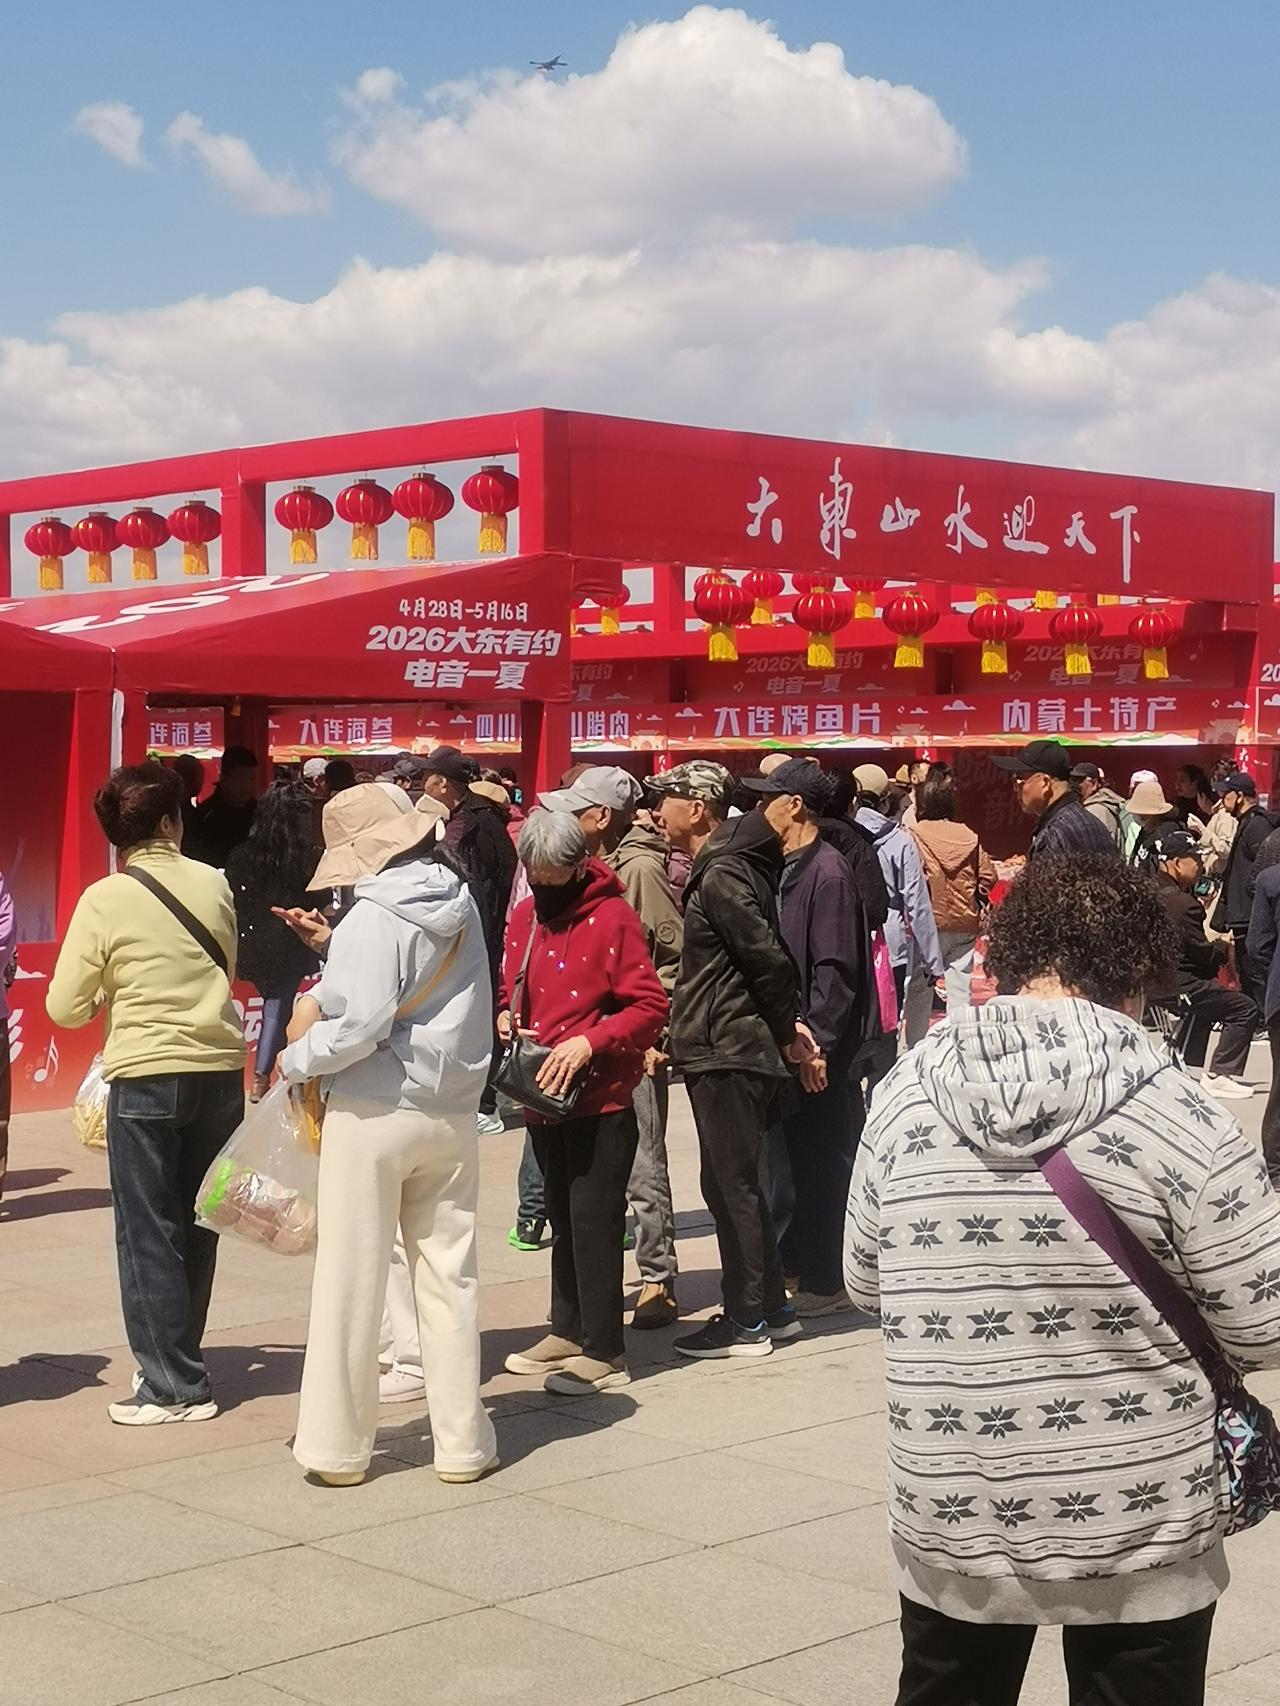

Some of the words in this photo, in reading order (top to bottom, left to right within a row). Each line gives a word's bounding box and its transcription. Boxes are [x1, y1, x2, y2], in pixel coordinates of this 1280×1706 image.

[399, 597, 528, 623] 4月28日-5月16日
[366, 625, 562, 656] 2026大东有约
[404, 658, 530, 690] 电音一夏
[766, 674, 843, 695] 电音一夏
[713, 703, 881, 737] 大连烤鱼片
[1003, 696, 1177, 732] 内蒙土特产
[300, 716, 392, 745] 大连海参
